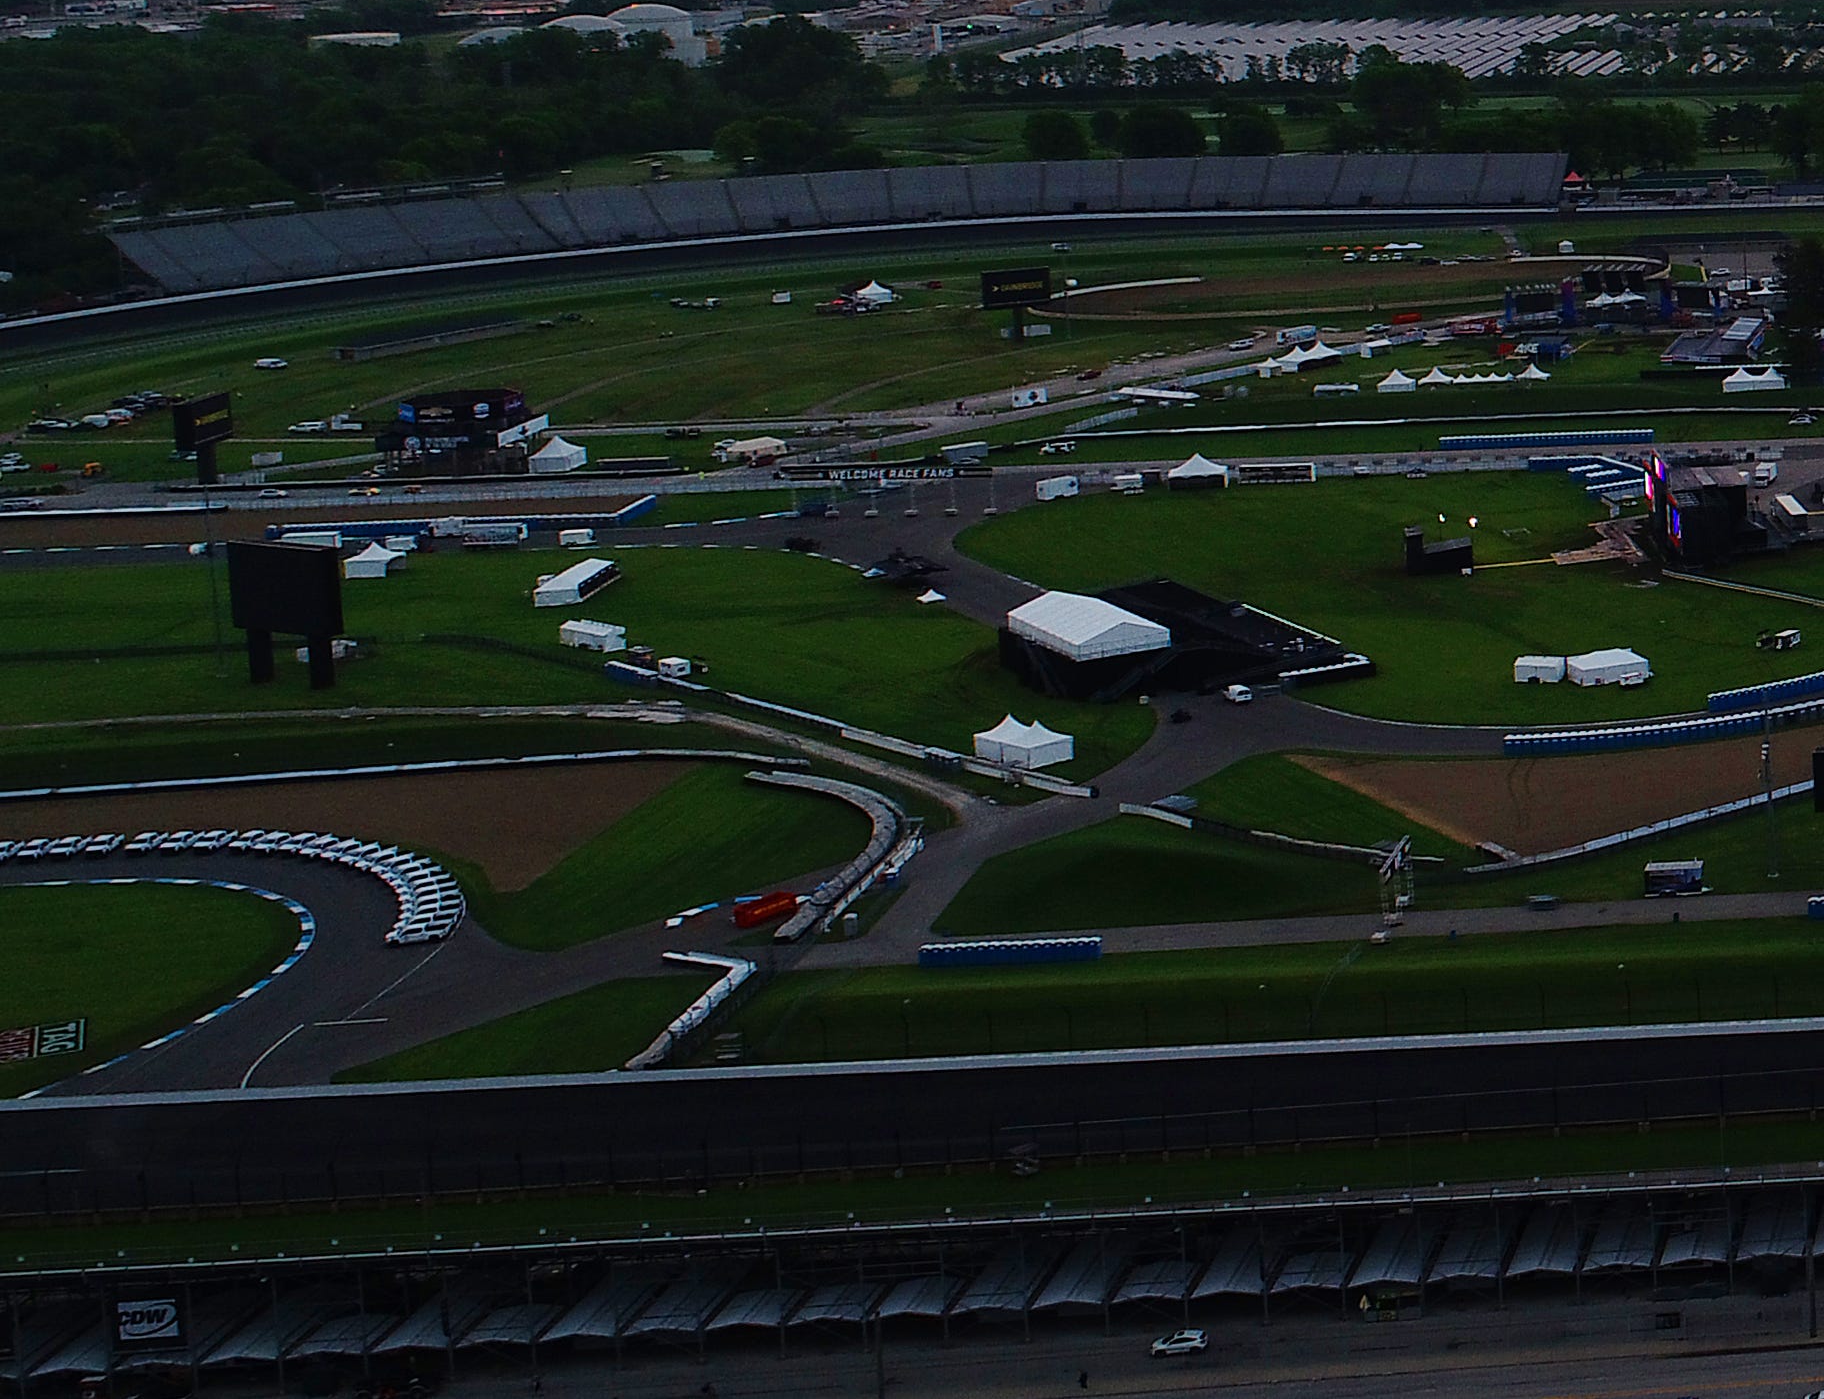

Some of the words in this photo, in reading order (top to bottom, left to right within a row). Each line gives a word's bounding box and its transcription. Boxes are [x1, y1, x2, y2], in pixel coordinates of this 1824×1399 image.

[829, 469, 885, 480] WELCOME
[889, 469, 919, 479] RACE
[923, 468, 954, 478] FANS
[40, 1022, 76, 1054] TAG
[119, 1309, 168, 1325] CDW
